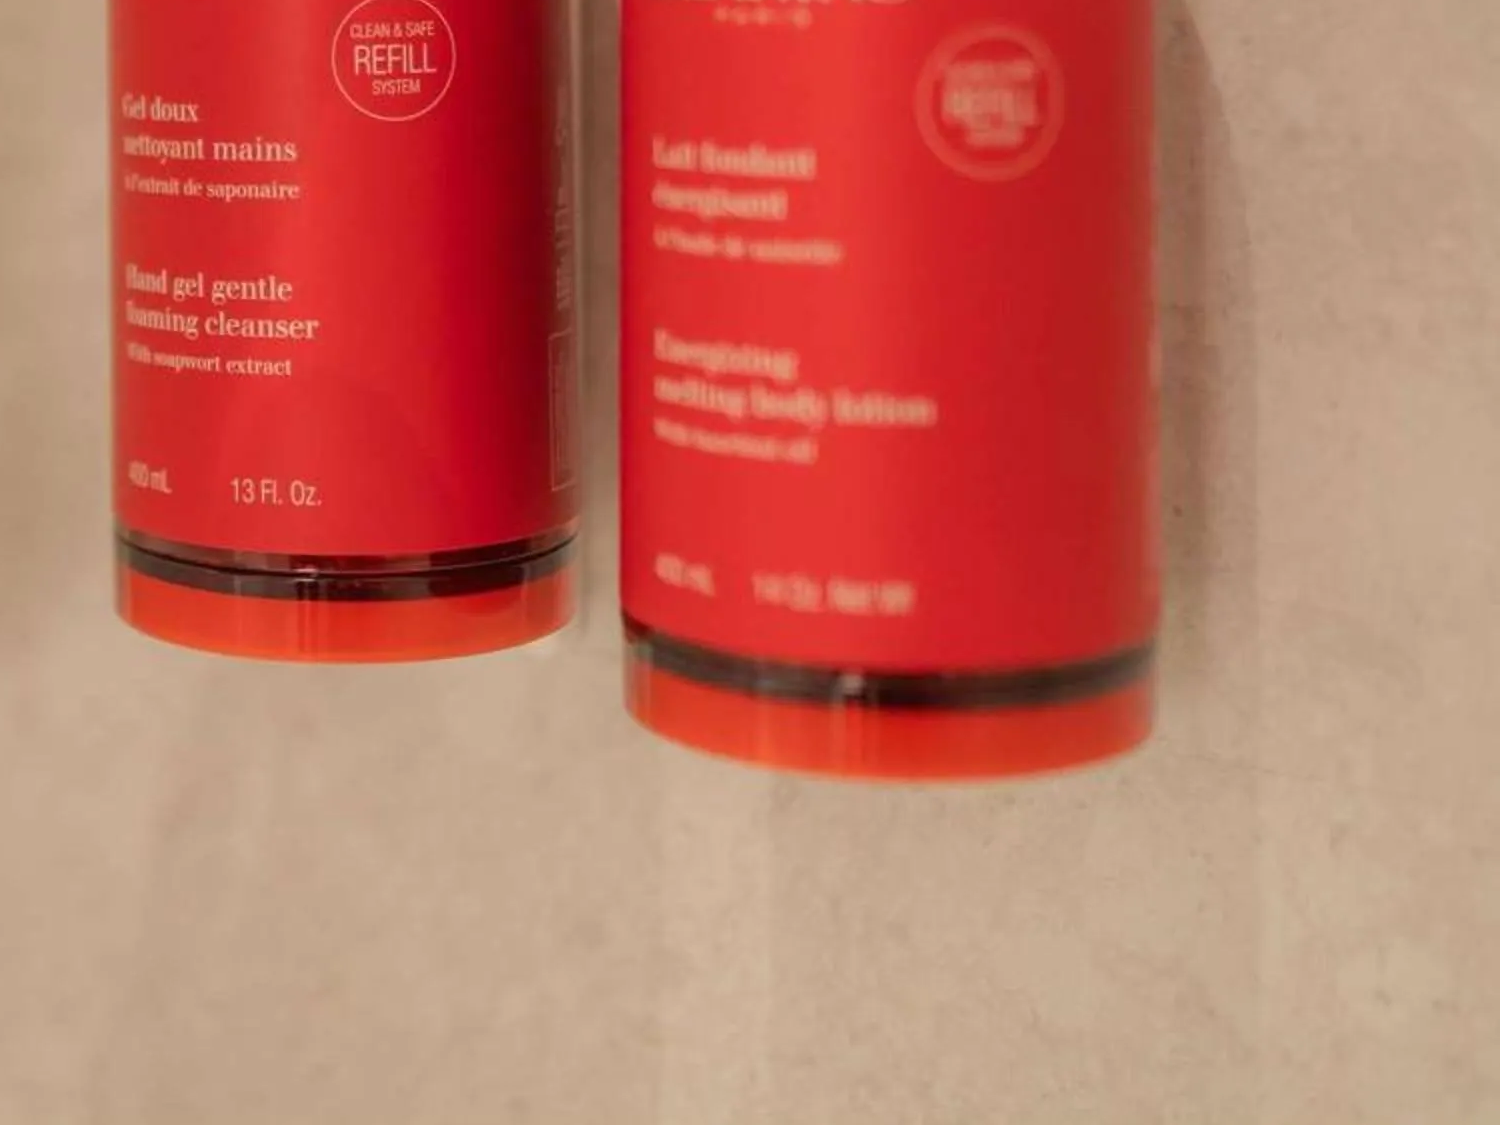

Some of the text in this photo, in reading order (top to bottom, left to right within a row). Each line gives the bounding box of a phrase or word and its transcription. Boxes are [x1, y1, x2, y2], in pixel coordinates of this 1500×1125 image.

[349, 20, 436, 39] CLEAN & SAFE
[353, 41, 438, 76] REFILL
[371, 78, 421, 96] SYSTEM
[121, 91, 200, 123] Gel doux
[122, 134, 298, 166] nettoyant mains
[182, 178, 202, 197] de
[206, 181, 300, 202] saponaire
[125, 262, 293, 306] Hand gel gentle
[125, 299, 320, 341] foaming cleanser
[225, 358, 292, 377] extract
[230, 476, 256, 505] 13
[261, 478, 284, 506] Fl.
[289, 479, 323, 507] Oz.
